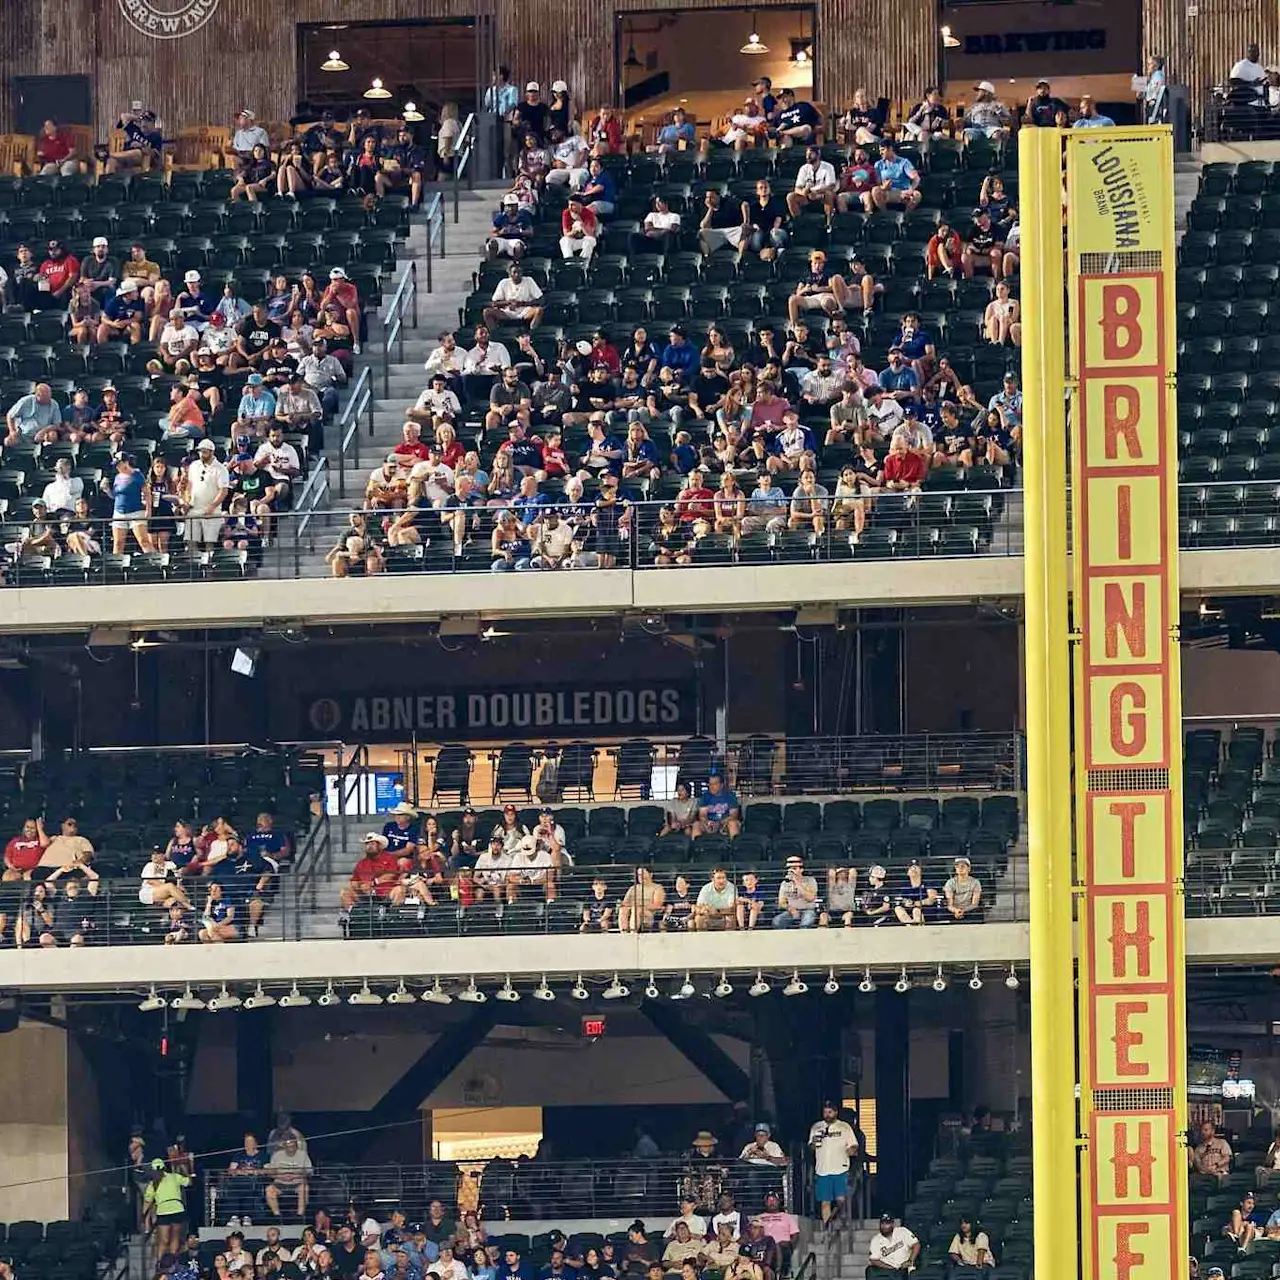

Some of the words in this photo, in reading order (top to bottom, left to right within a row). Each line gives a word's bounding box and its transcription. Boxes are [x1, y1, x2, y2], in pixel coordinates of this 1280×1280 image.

[1091, 146, 1140, 249] LOUISIANA
[1093, 189, 1109, 216] BRAND
[250, 330, 269, 340] AERO
[1098, 283, 1148, 758] BRING
[351, 695, 456, 730] ABNER
[468, 689, 680, 727] DOUBLEDOGS
[1107, 801, 1155, 1076] THE
